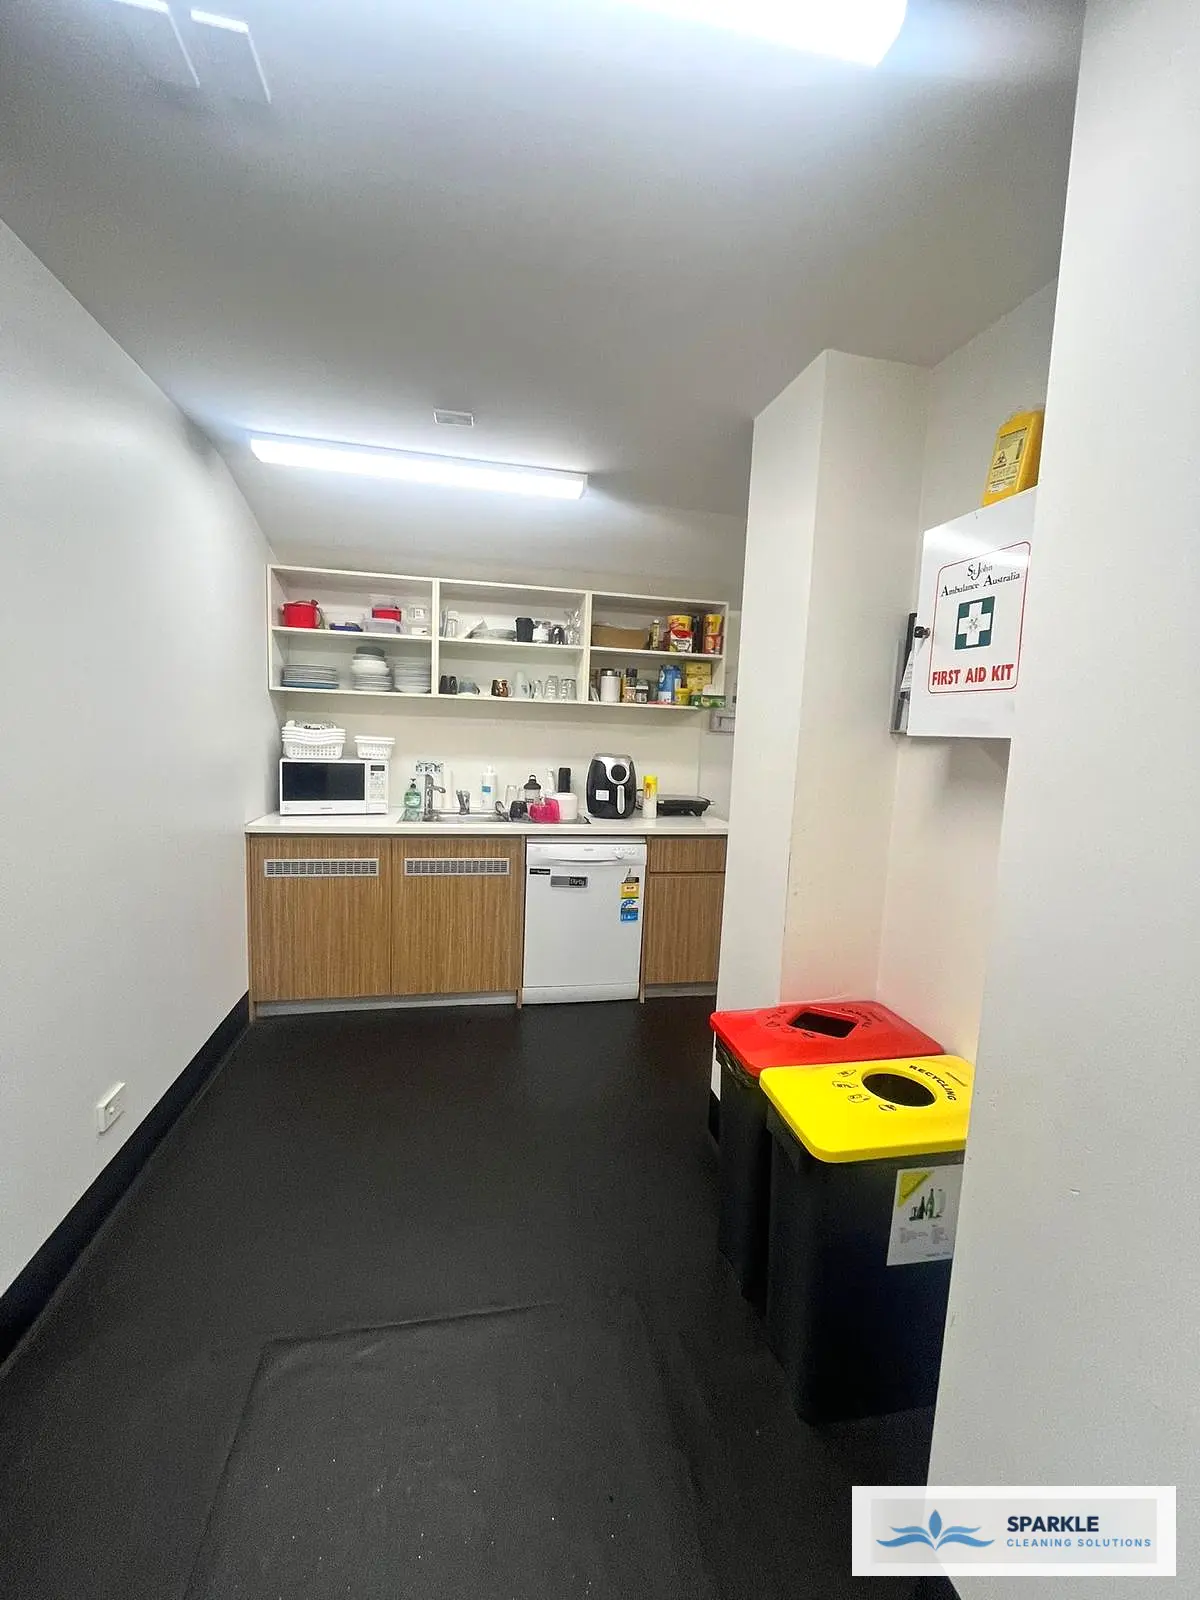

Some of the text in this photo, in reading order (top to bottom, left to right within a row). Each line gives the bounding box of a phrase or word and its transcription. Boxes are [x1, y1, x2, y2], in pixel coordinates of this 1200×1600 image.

[971, 562, 993, 581] John
[941, 571, 1021, 597] Ambulance Australia
[932, 669, 961, 686] FIRST
[965, 667, 987, 683] AID
[991, 664, 1014, 682] KIT
[909, 1065, 957, 1101] RECYCLING
